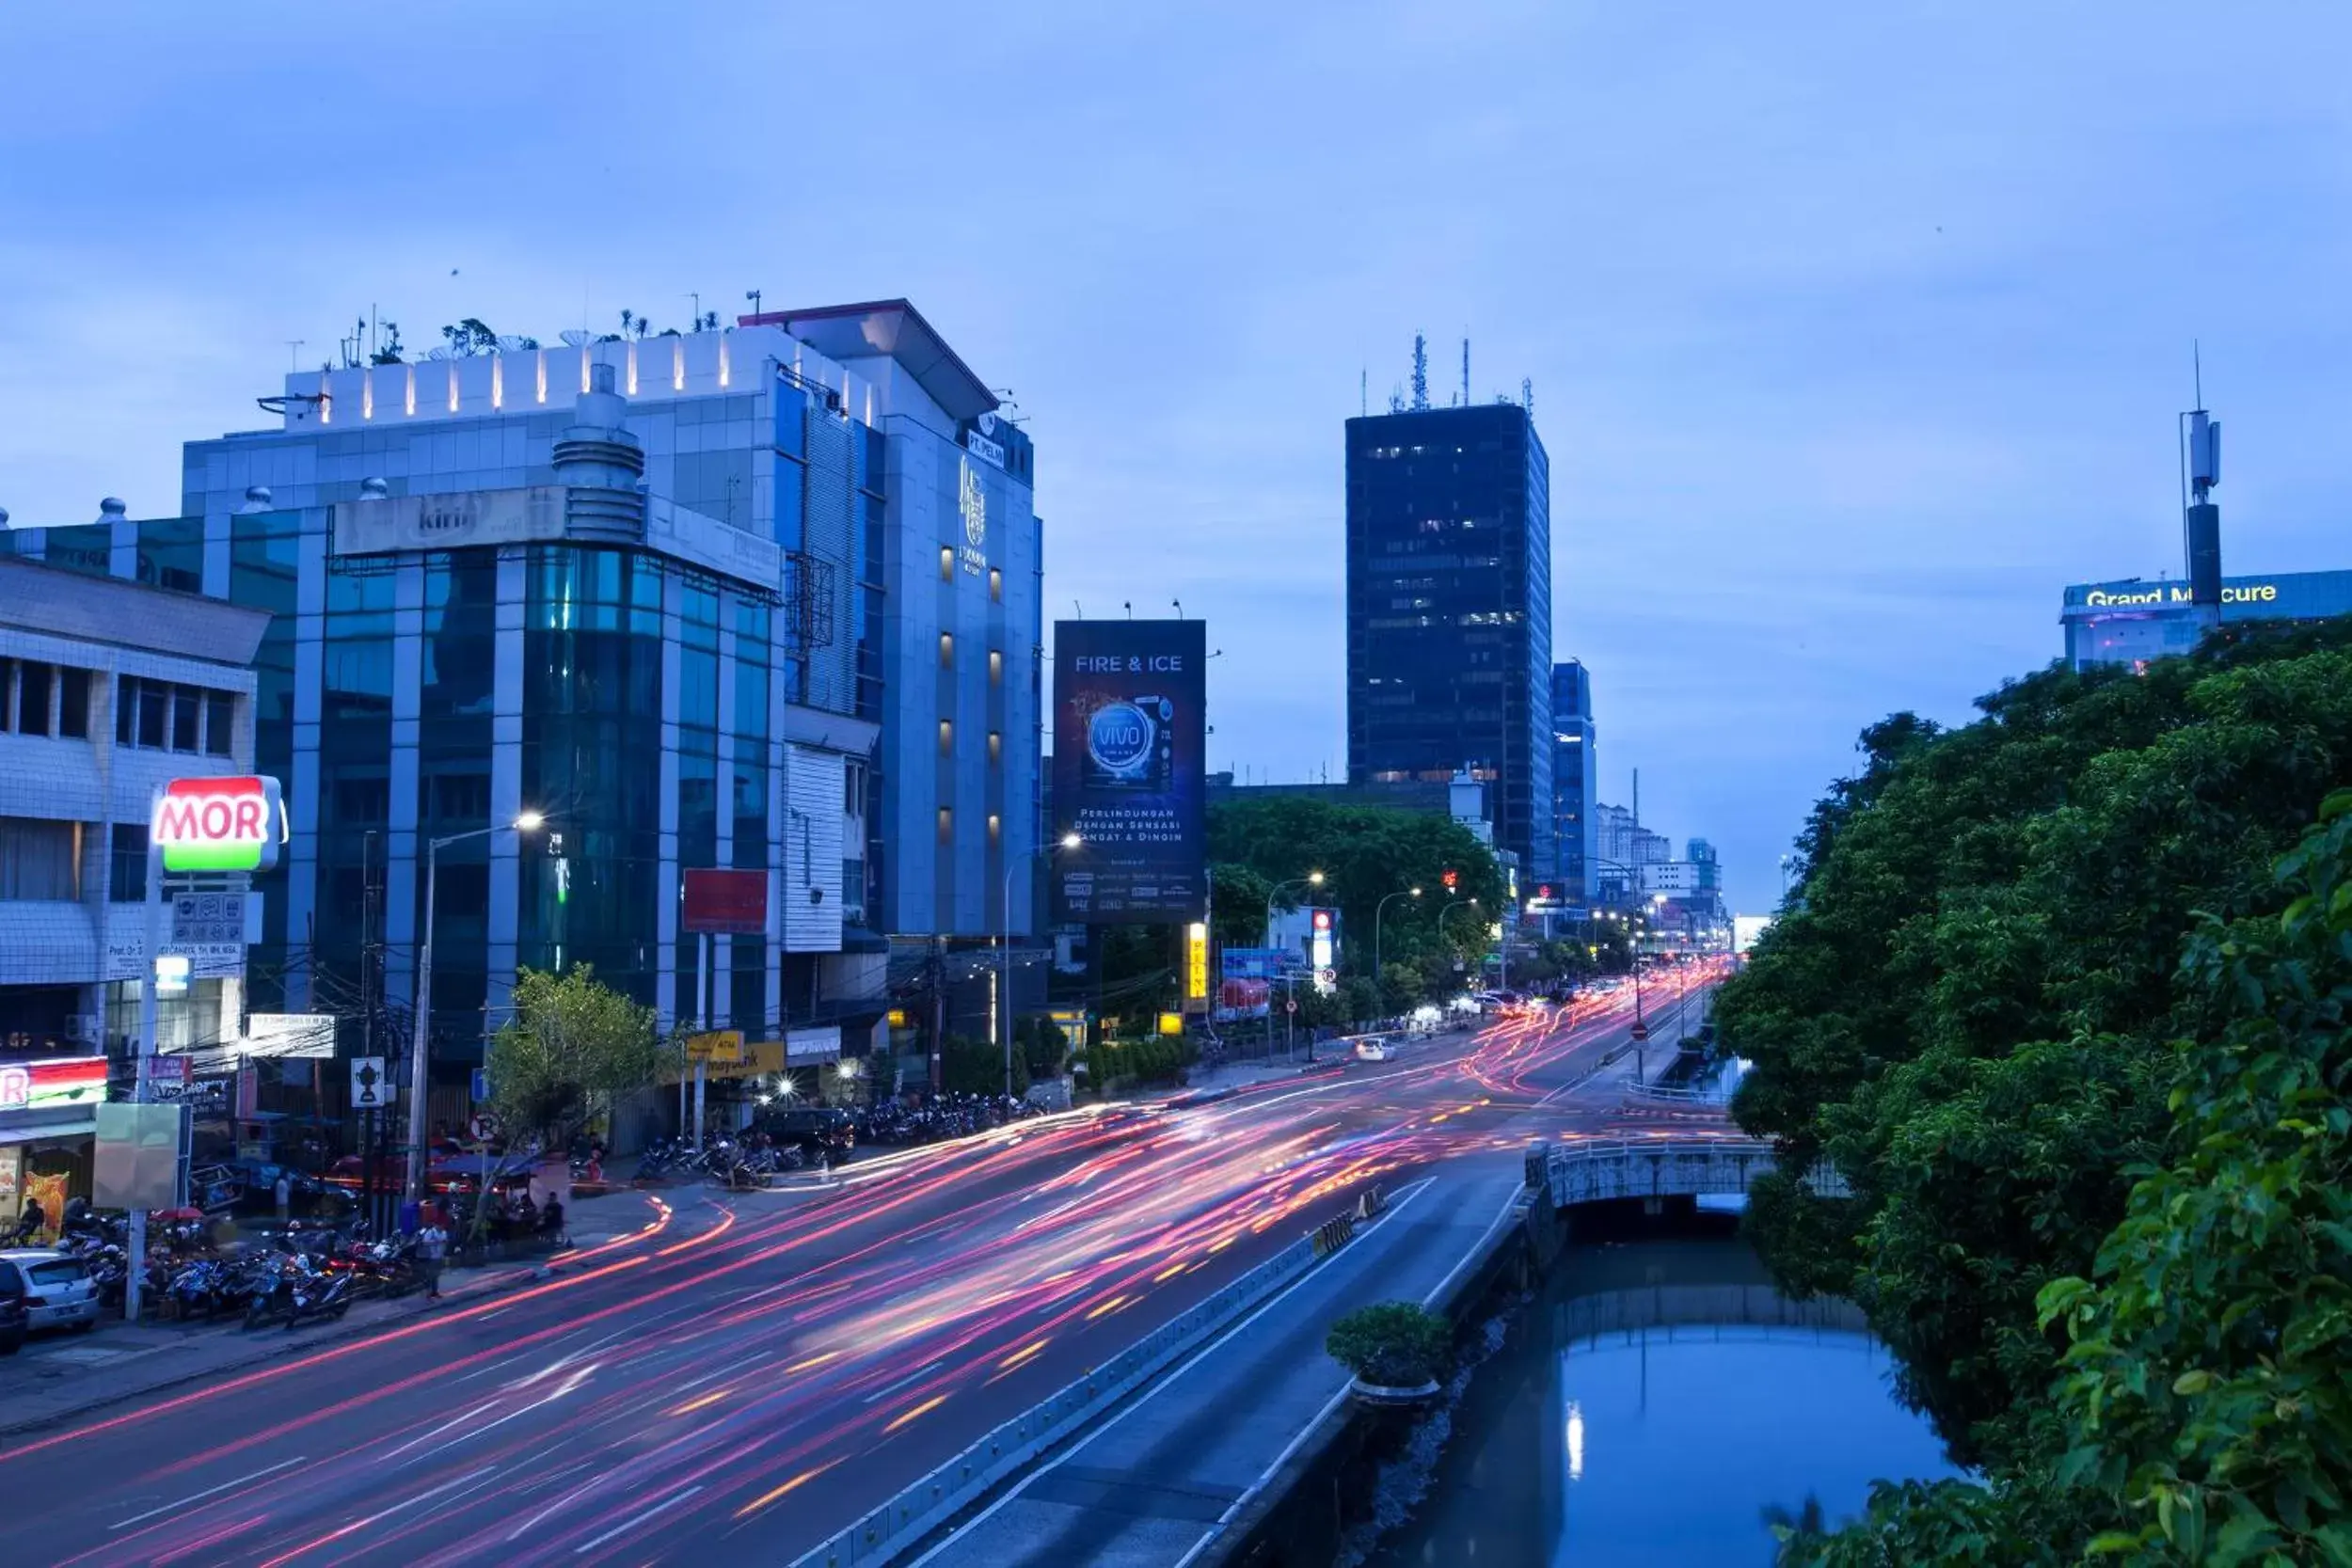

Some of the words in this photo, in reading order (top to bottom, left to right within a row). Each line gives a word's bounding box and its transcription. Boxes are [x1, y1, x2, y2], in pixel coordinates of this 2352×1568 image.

[2087, 590, 2162, 606] Grand
[2170, 584, 2277, 604] Mcure
[1075, 656, 1122, 673] FIRE
[1128, 656, 1142, 673] &
[1149, 656, 1183, 672] ICE
[1099, 726, 1140, 746] VIVO
[156, 799, 262, 841] MOR
[1080, 808, 1174, 818] PERLINDUNGAN
[1074, 820, 1124, 830] DENGAN
[1138, 832, 1183, 842] DINGIN
